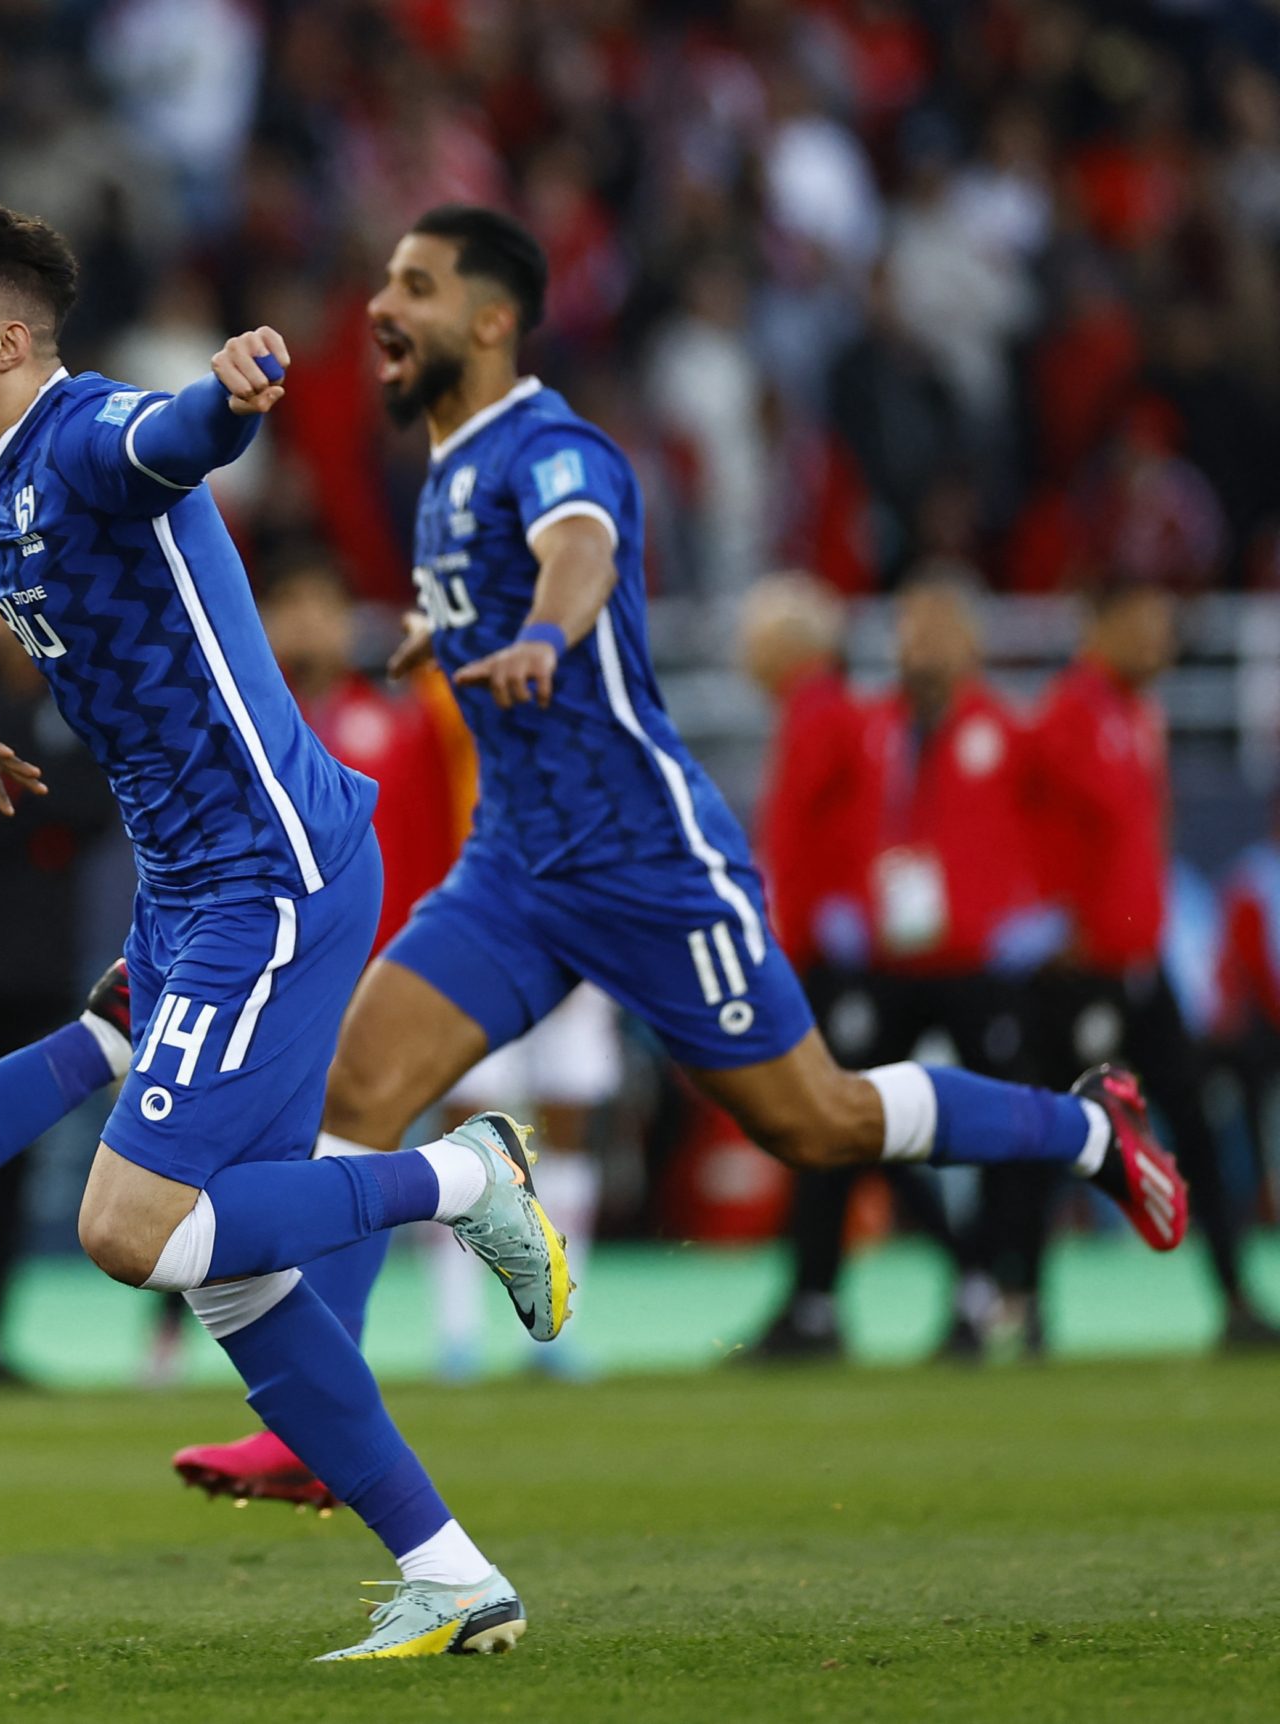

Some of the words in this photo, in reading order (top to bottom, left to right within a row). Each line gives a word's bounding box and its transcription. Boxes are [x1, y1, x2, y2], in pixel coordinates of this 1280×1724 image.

[11, 585, 48, 605] STORE
[687, 920, 748, 1006] 11
[135, 993, 218, 1087] 14
